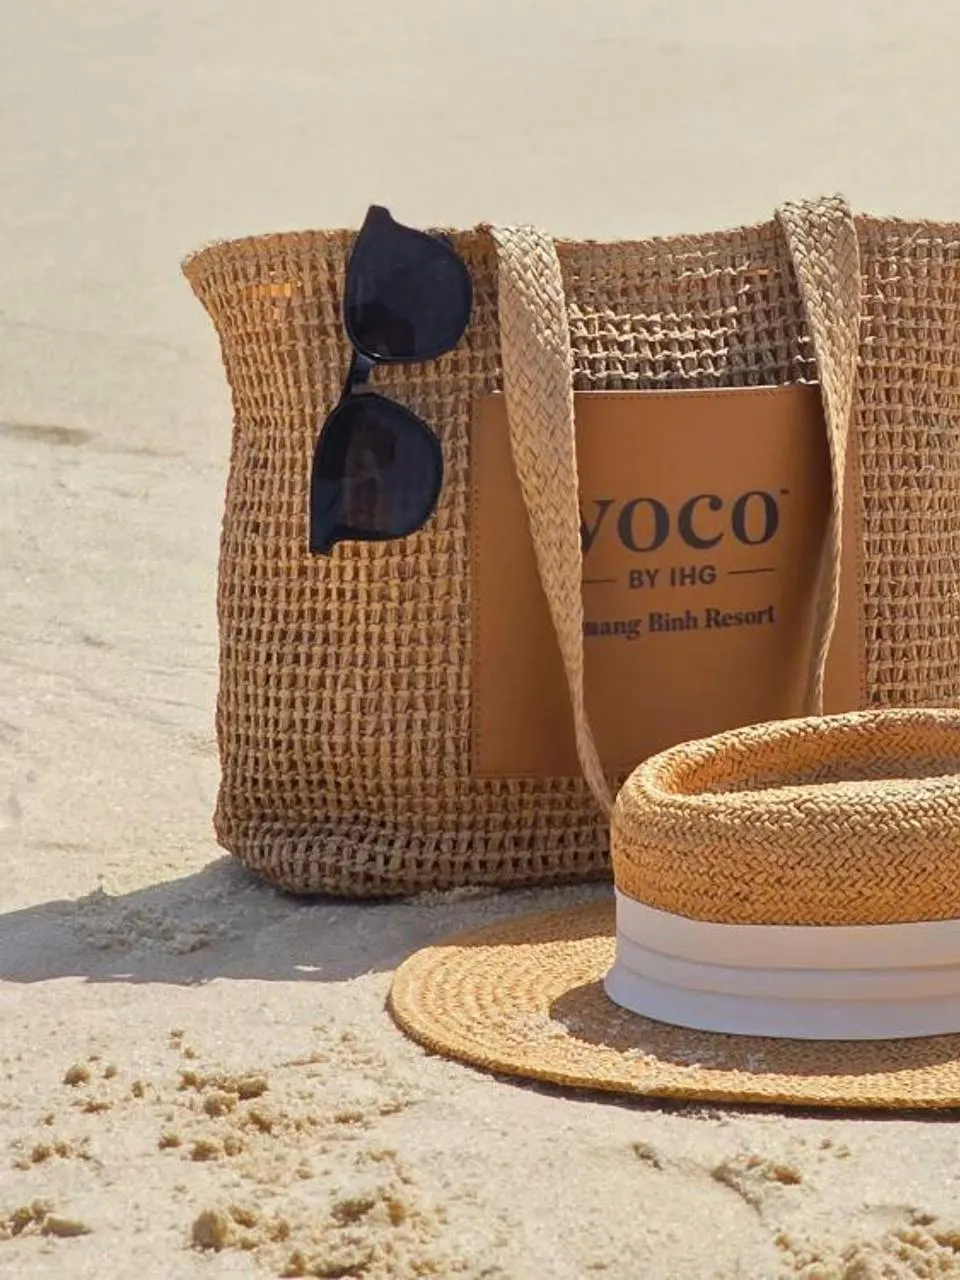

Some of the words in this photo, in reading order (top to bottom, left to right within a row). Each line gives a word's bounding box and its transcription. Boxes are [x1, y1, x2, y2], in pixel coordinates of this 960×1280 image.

[629, 570, 659, 589] BY
[670, 566, 717, 587] IHG
[582, 619, 642, 640] uang
[648, 609, 699, 632] Binh
[705, 605, 774, 629] Resort
